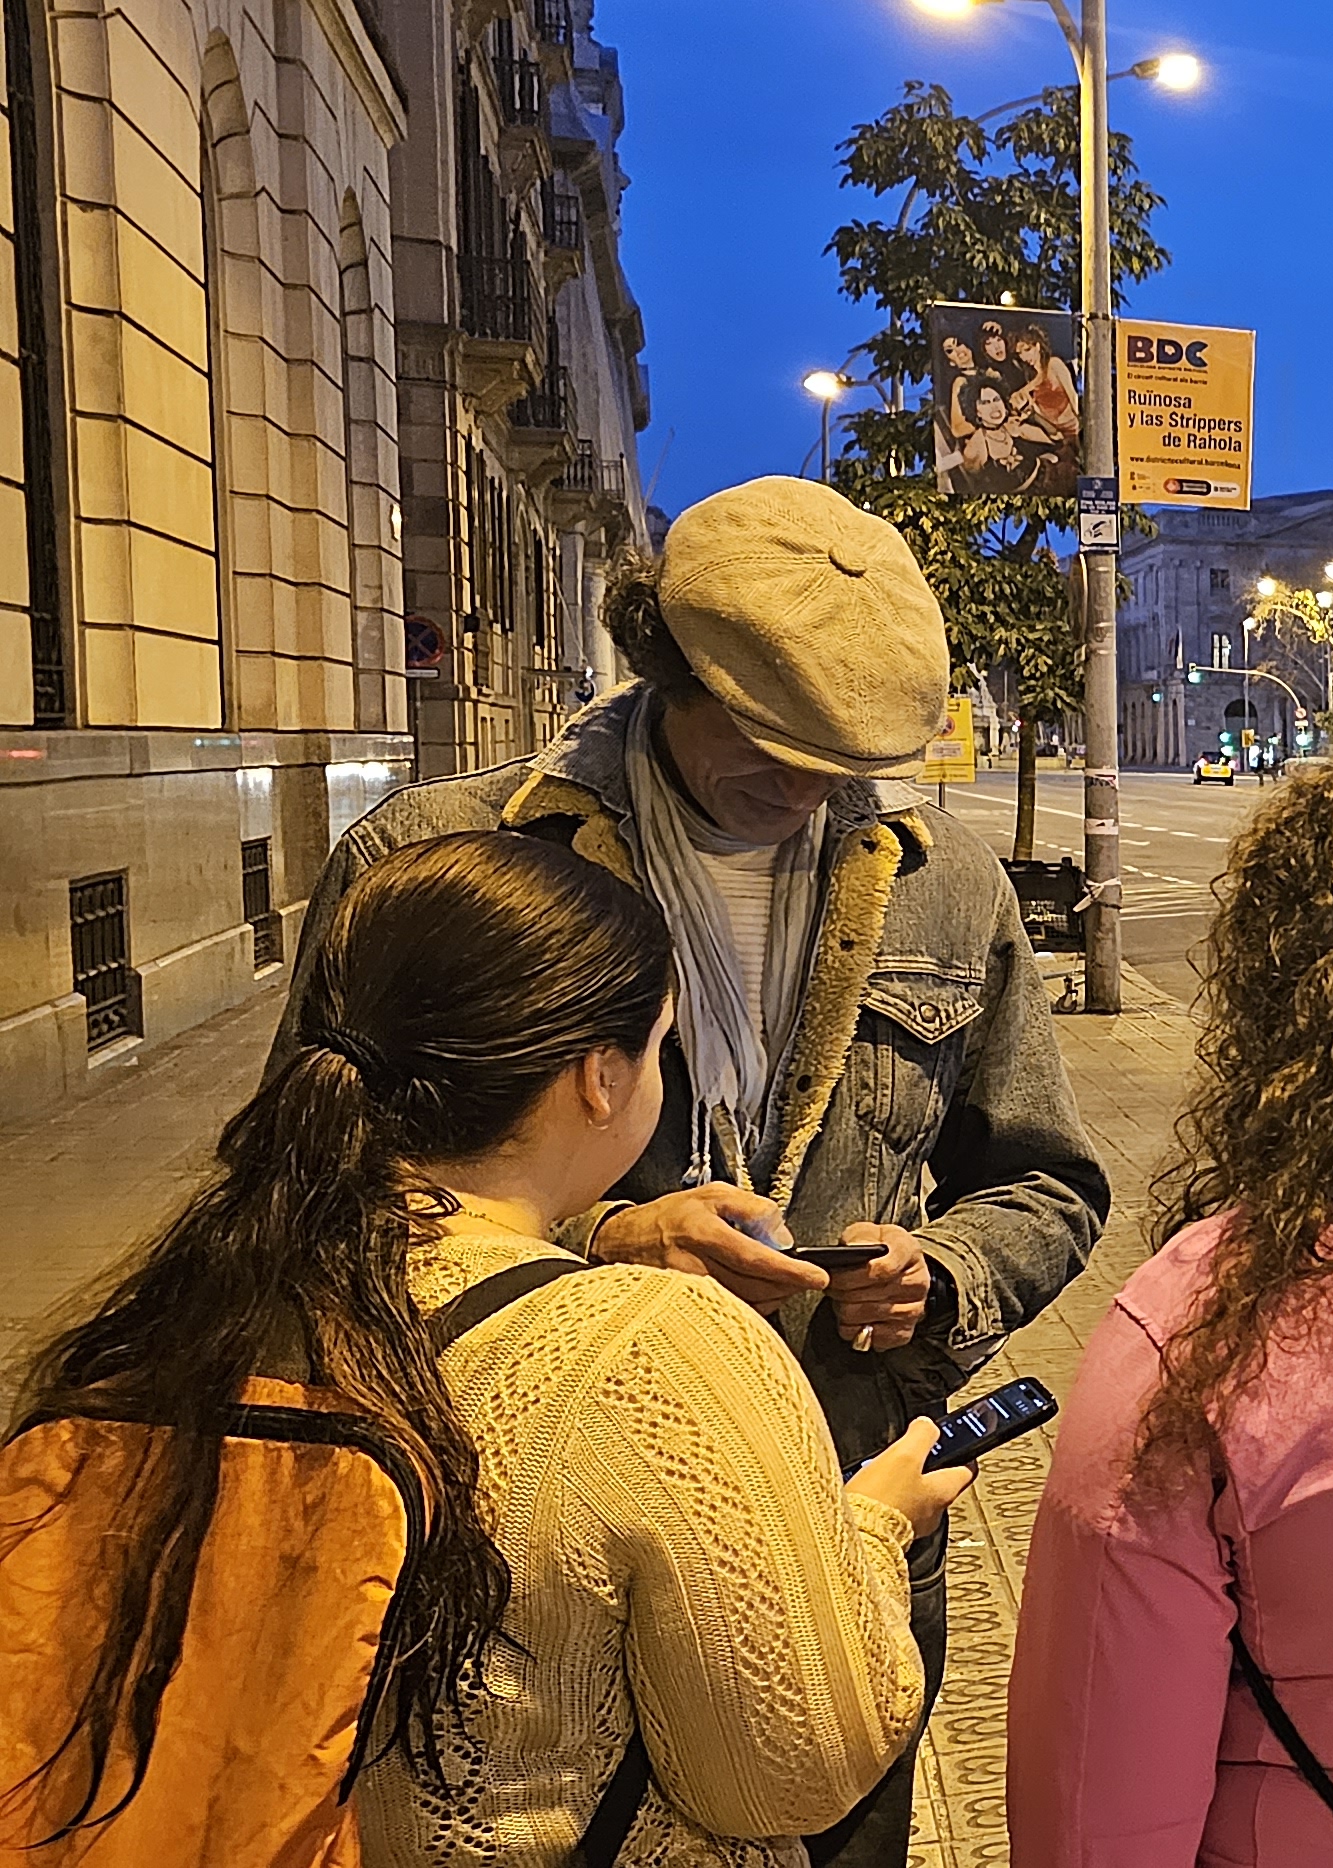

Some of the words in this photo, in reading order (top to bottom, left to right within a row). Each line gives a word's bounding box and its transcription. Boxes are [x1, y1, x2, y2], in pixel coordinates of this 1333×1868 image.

[1126, 335, 1208, 368] BDC
[1127, 389, 1192, 409] Ruïnosa
[1127, 412, 1136, 428] y
[1140, 410, 1163, 427] las
[1168, 411, 1243, 433] Strippers
[1162, 431, 1181, 448] de
[1187, 433, 1242, 452] Rahola
